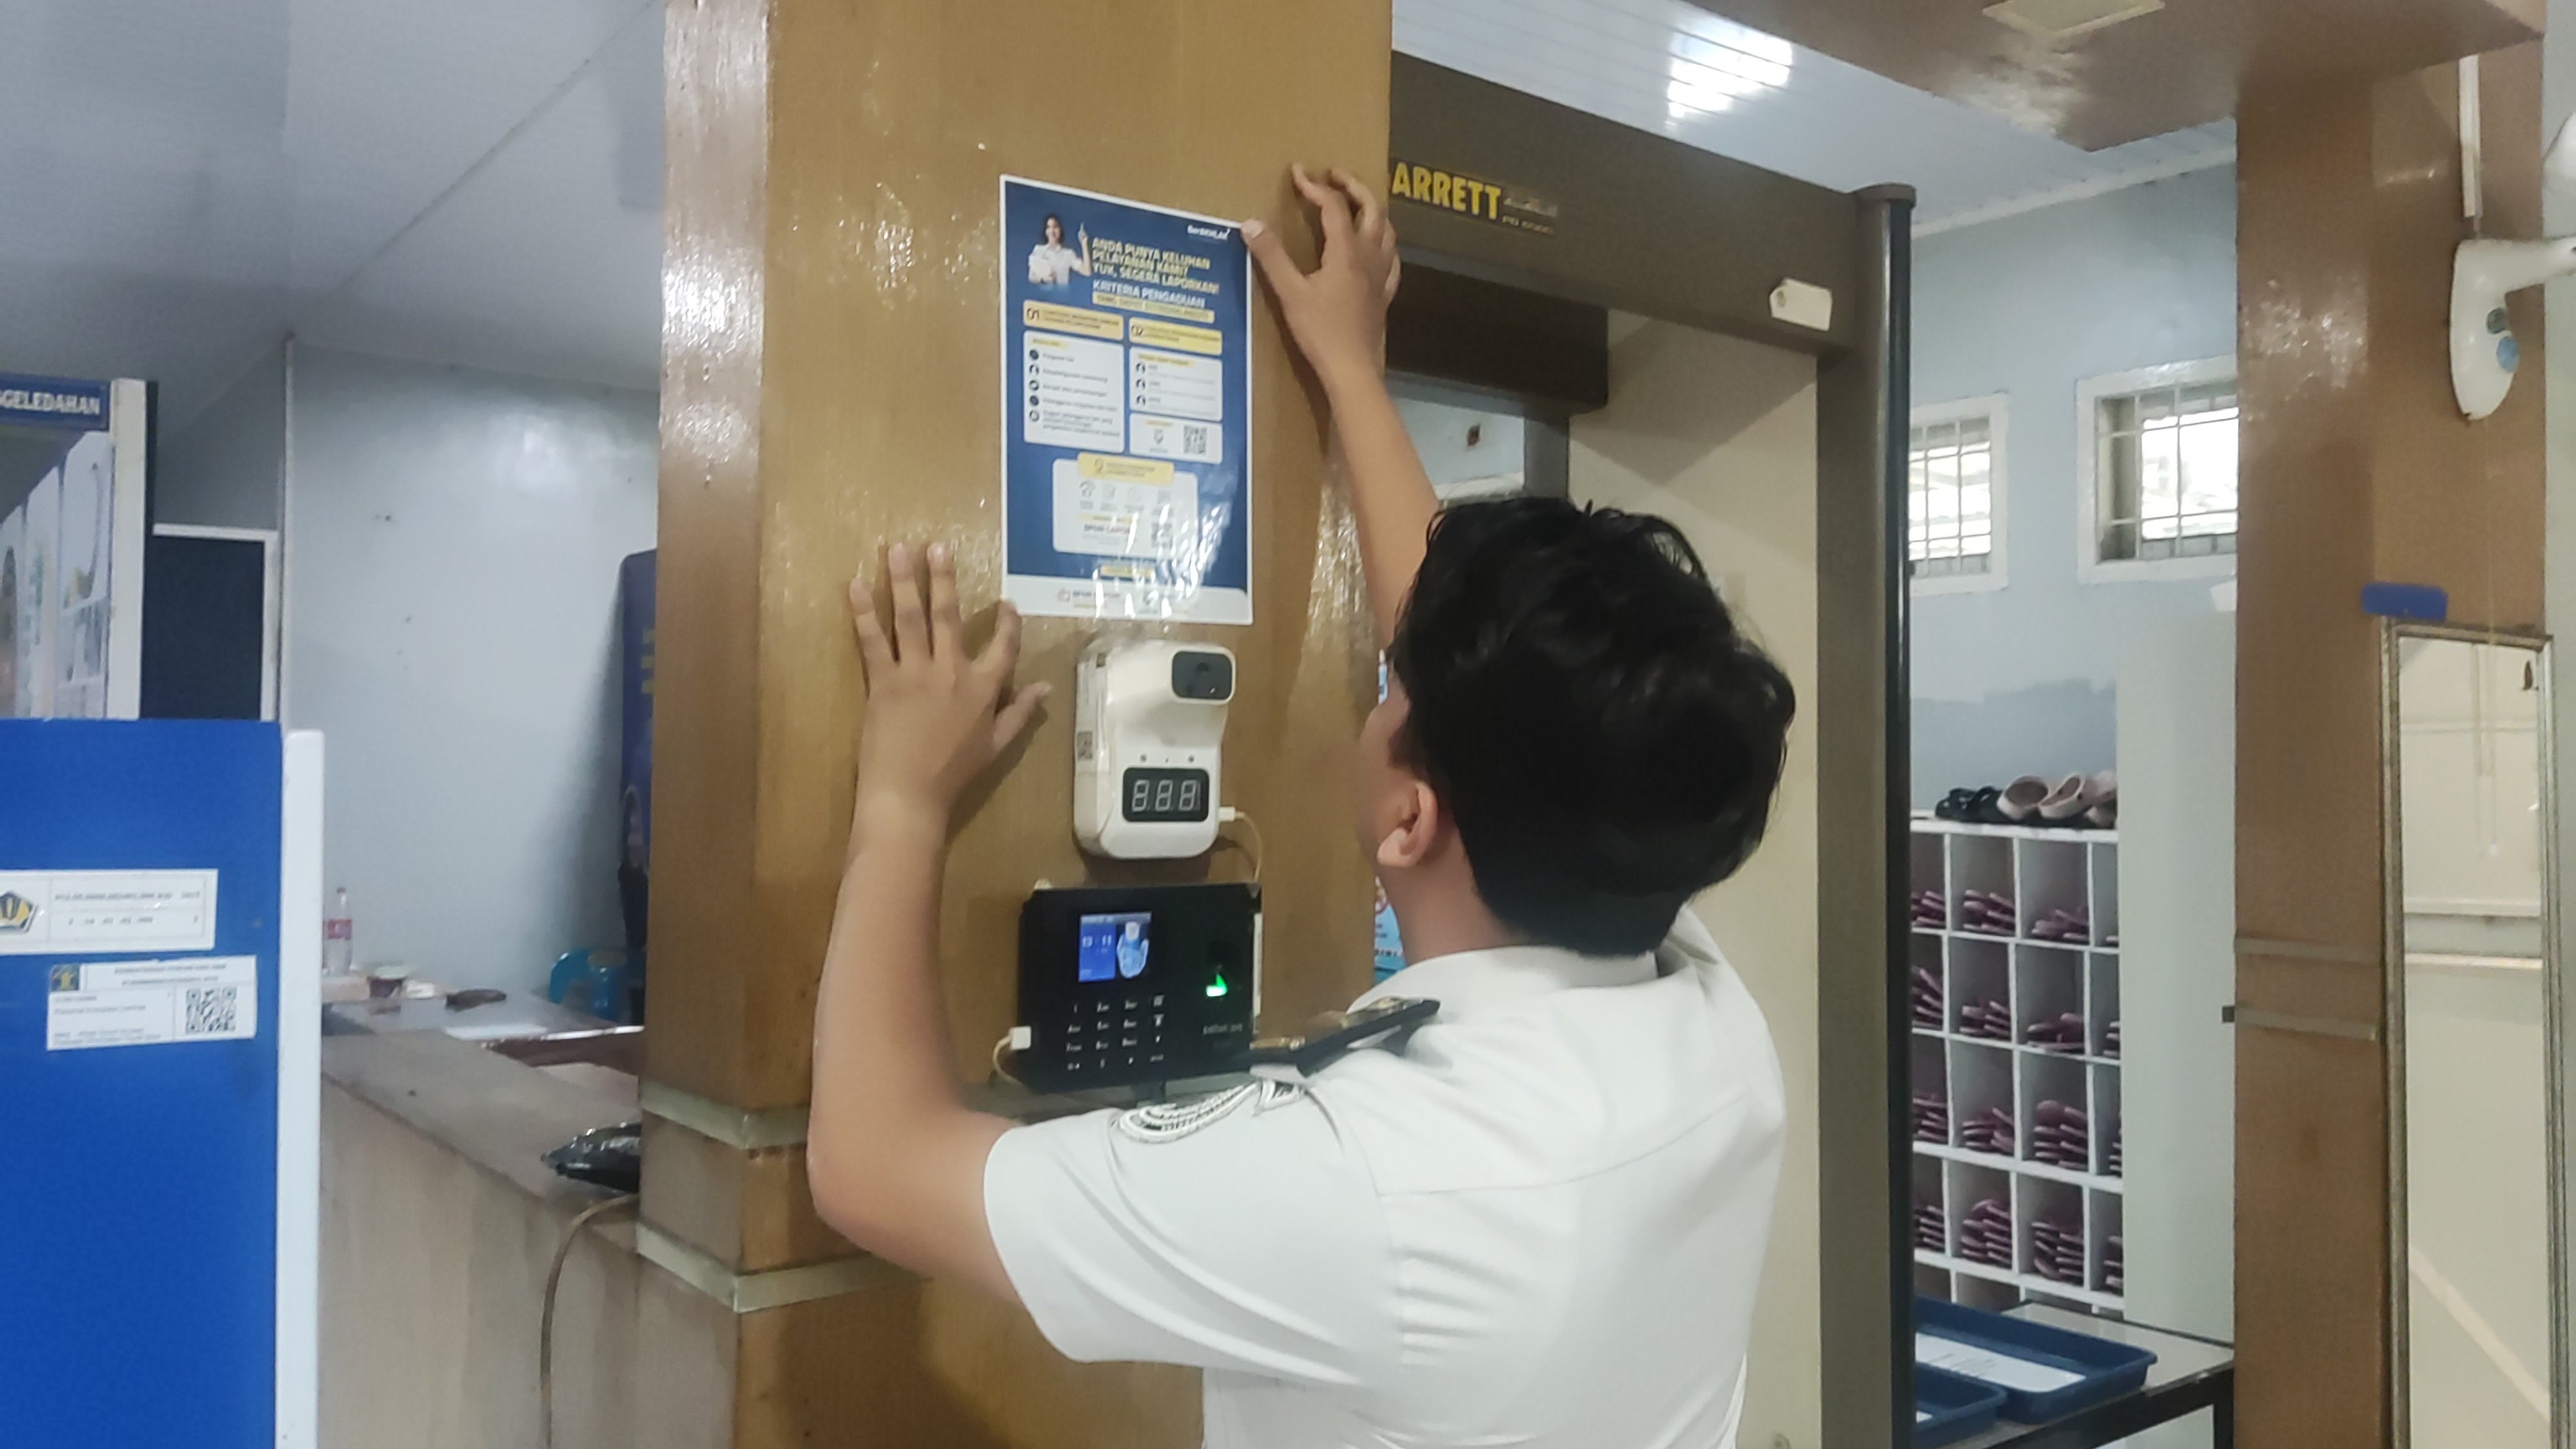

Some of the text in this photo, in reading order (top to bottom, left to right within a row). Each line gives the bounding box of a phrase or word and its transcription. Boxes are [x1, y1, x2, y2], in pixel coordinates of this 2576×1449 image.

[1392, 162, 1501, 220] ARRETT
[1092, 237, 1210, 270] ANDA PUNYA KELUHAN
[1092, 249, 1155, 270] PELAYANAN
[1093, 261, 1118, 278] YUK,
[1119, 266, 1161, 284] SEGERA
[1092, 278, 1205, 308] KRITERIA PENGADUAN
[0, 389, 100, 415] GELEDAHAN
